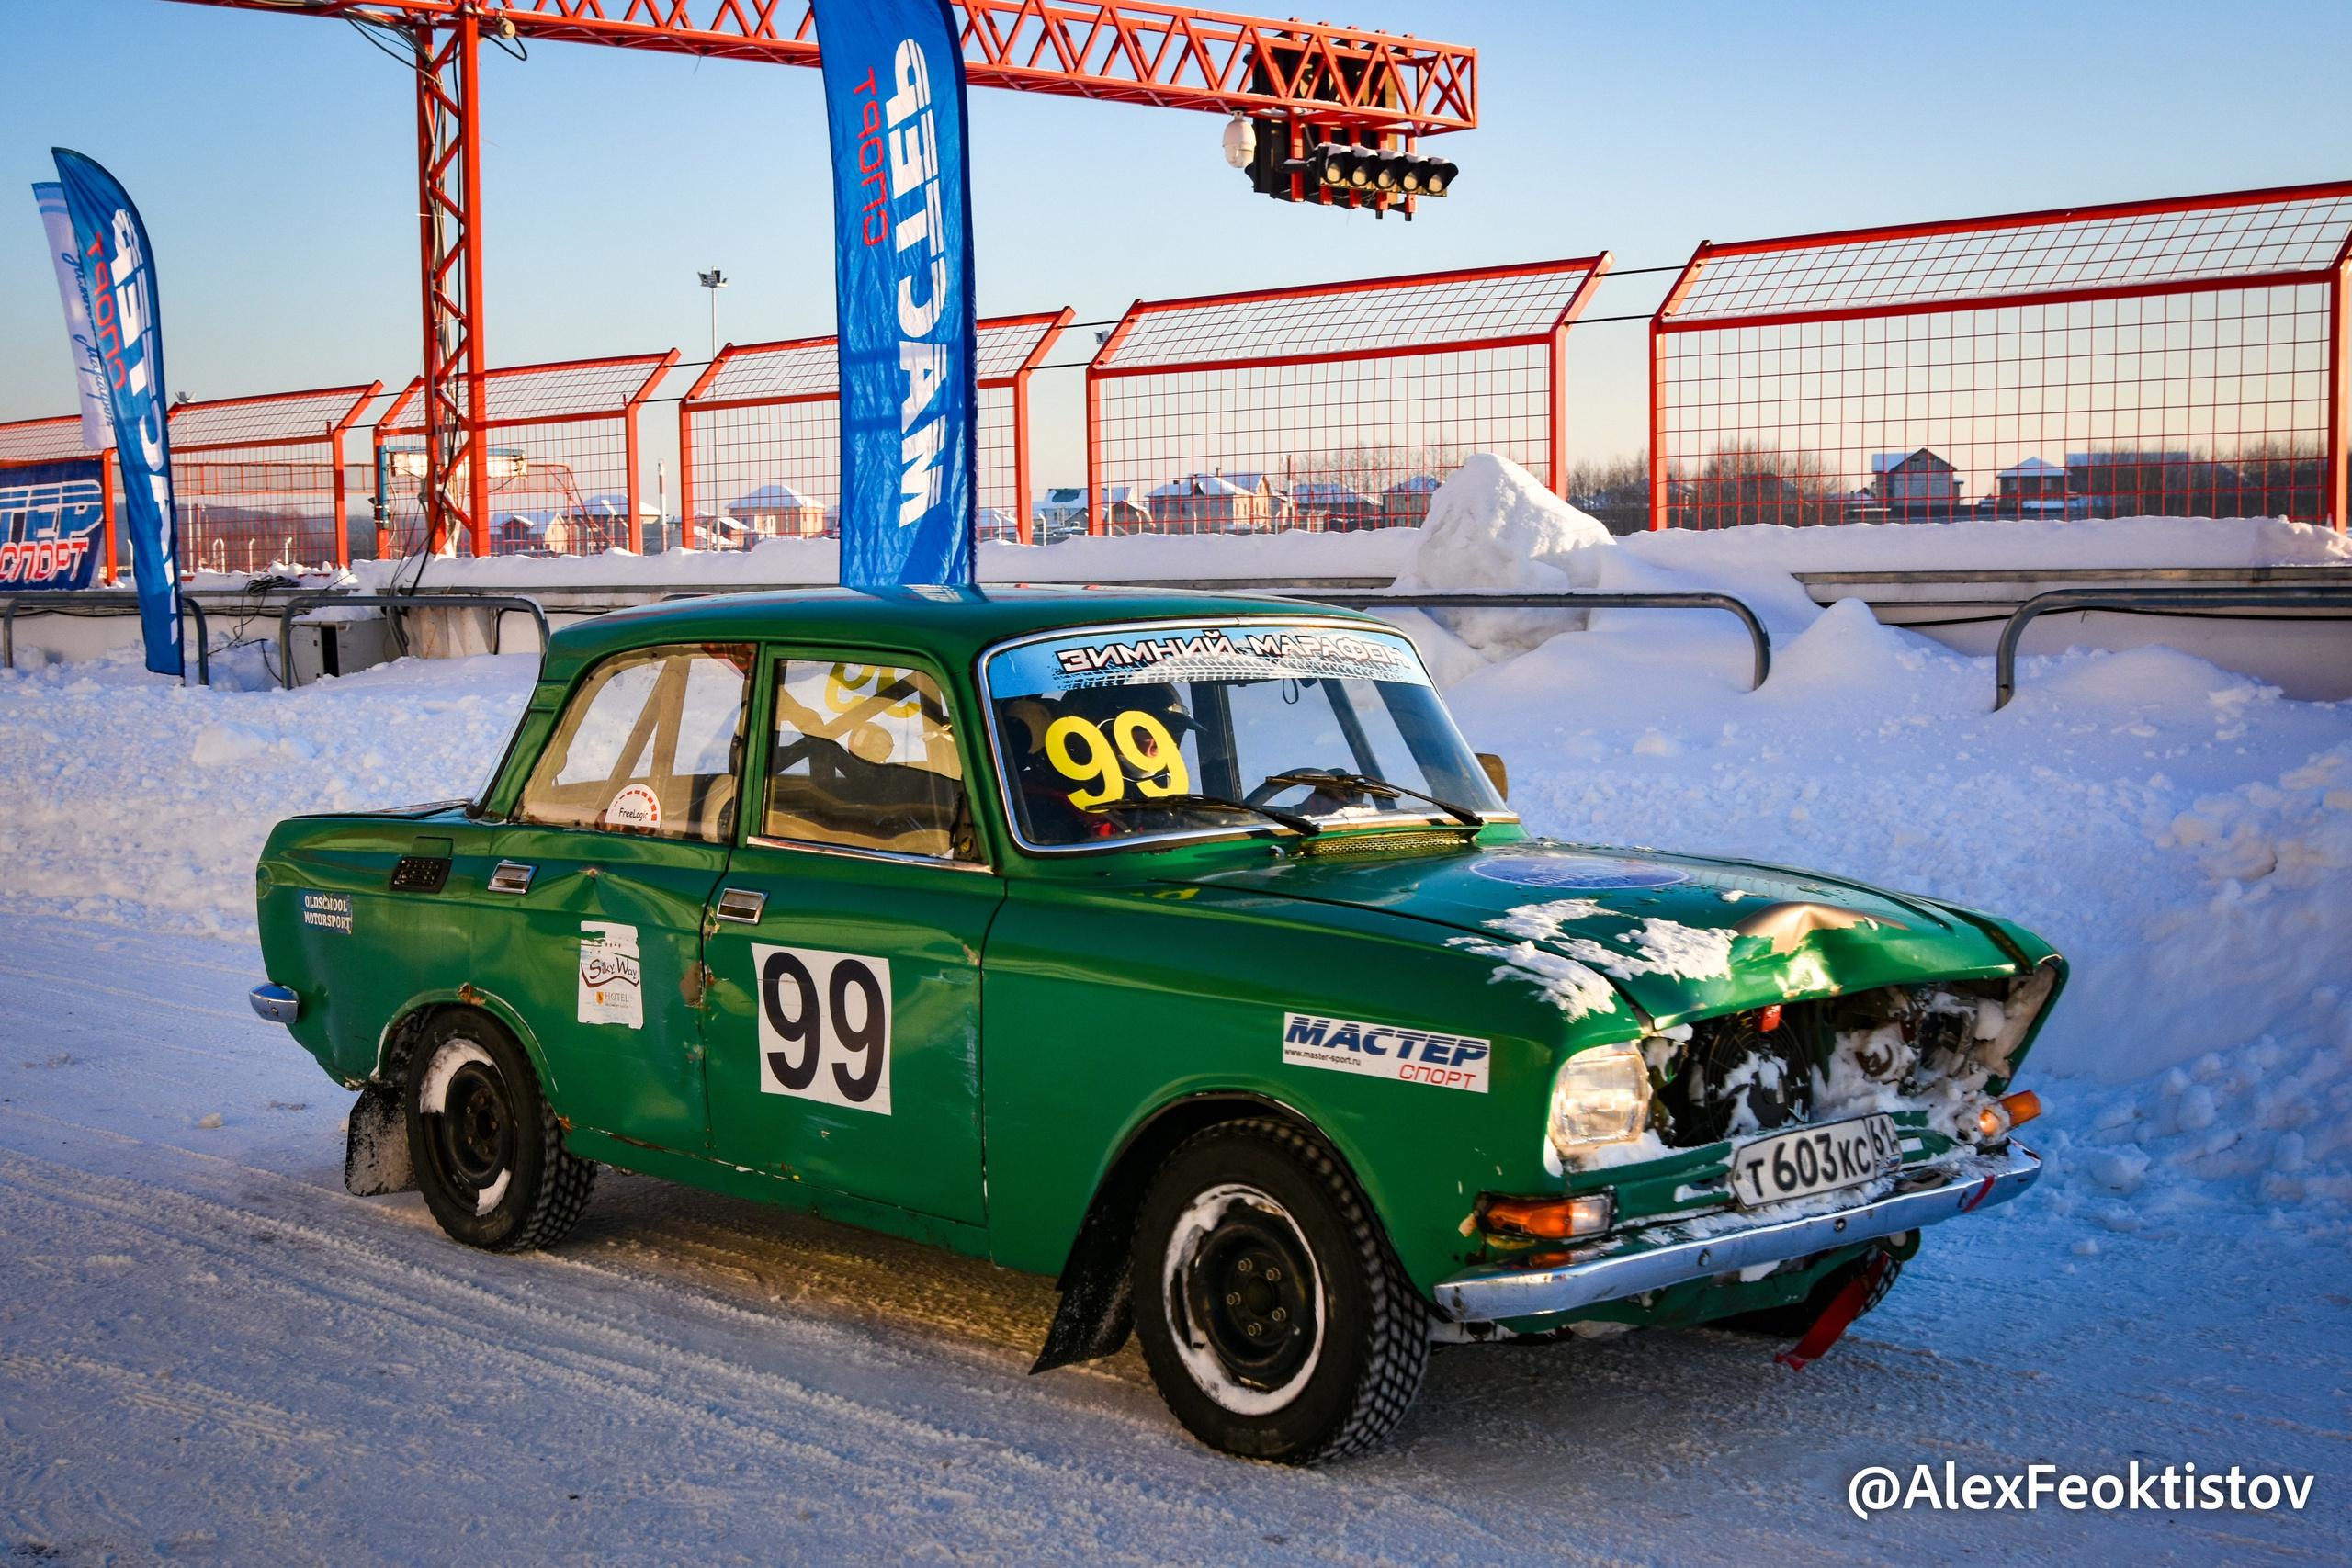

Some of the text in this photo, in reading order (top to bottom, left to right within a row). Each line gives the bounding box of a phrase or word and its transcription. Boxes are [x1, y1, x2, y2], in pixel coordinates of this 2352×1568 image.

[0, 537, 89, 583] СПОРТ
[1057, 629, 1410, 673] ЗИМНИЙ МАРАФОН
[1046, 711, 1189, 814] 99
[619, 807, 648, 821] FreeLogic
[304, 895, 348, 912] OLDSCHOOL
[304, 911, 352, 929] MOTORSPORT
[616, 957, 638, 980] Way
[605, 991, 629, 1003] HOTEL
[763, 952, 886, 1103] 99
[1284, 1016, 1488, 1067] МАСТЕР
[1284, 1048, 1362, 1066] www.master-sport.ru
[1399, 1064, 1476, 1089] СПОРТ
[1870, 1117, 1894, 1156] 61
